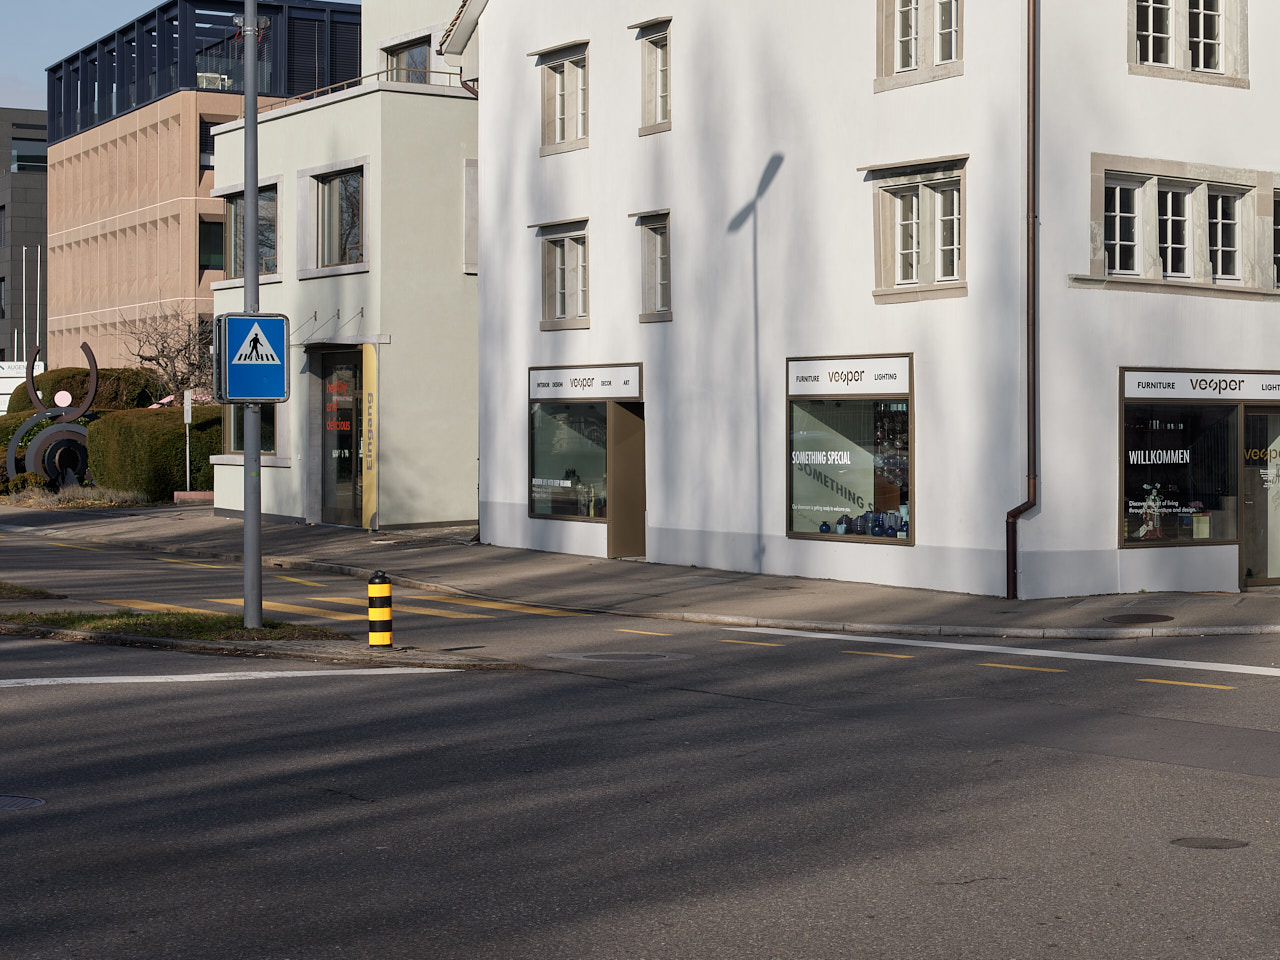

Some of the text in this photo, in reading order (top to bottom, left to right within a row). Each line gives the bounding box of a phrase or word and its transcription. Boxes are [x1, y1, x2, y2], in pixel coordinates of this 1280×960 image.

[569, 377, 595, 391] vesper
[795, 370, 898, 386] FURNITURE vesper LIGHTING
[326, 380, 348, 396] healthy
[1137, 381, 1176, 390] FURNITURE
[1189, 378, 1245, 395] vesper
[326, 399, 338, 412] and
[326, 417, 351, 431] delicious
[366, 392, 374, 471] Eingang
[791, 450, 852, 465] SOMETHING SPECIAL
[1128, 449, 1190, 465] WILLKOMMEN
